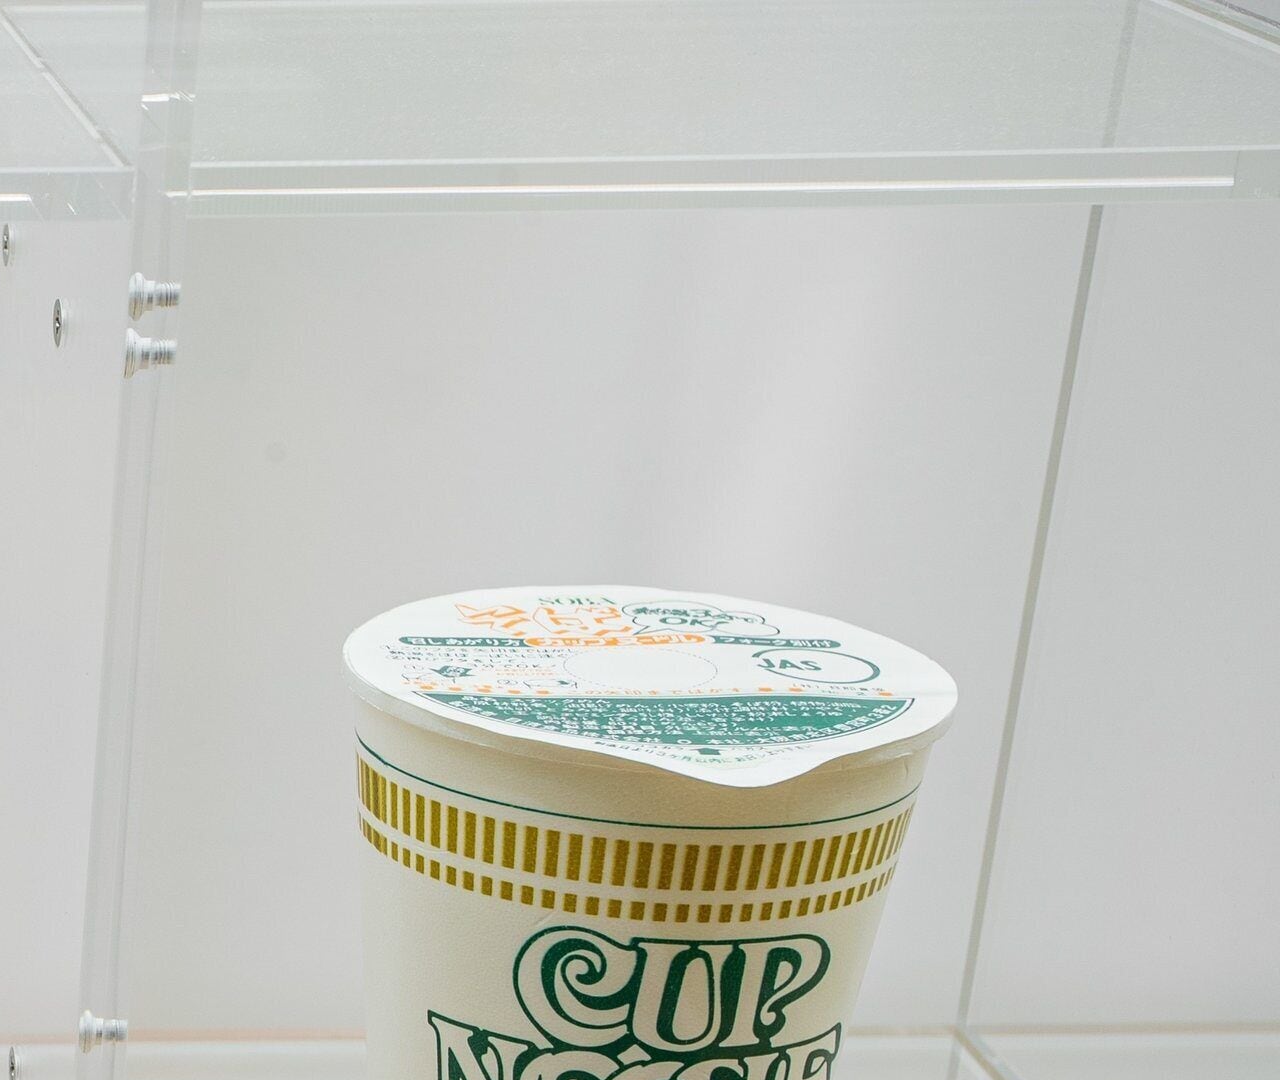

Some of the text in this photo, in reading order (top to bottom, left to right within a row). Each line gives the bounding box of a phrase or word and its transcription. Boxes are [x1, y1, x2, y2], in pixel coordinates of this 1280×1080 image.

[407, 637, 521, 647] 召しあがり方
[756, 658, 822, 671] JAS
[512, 925, 831, 1052] CUP
